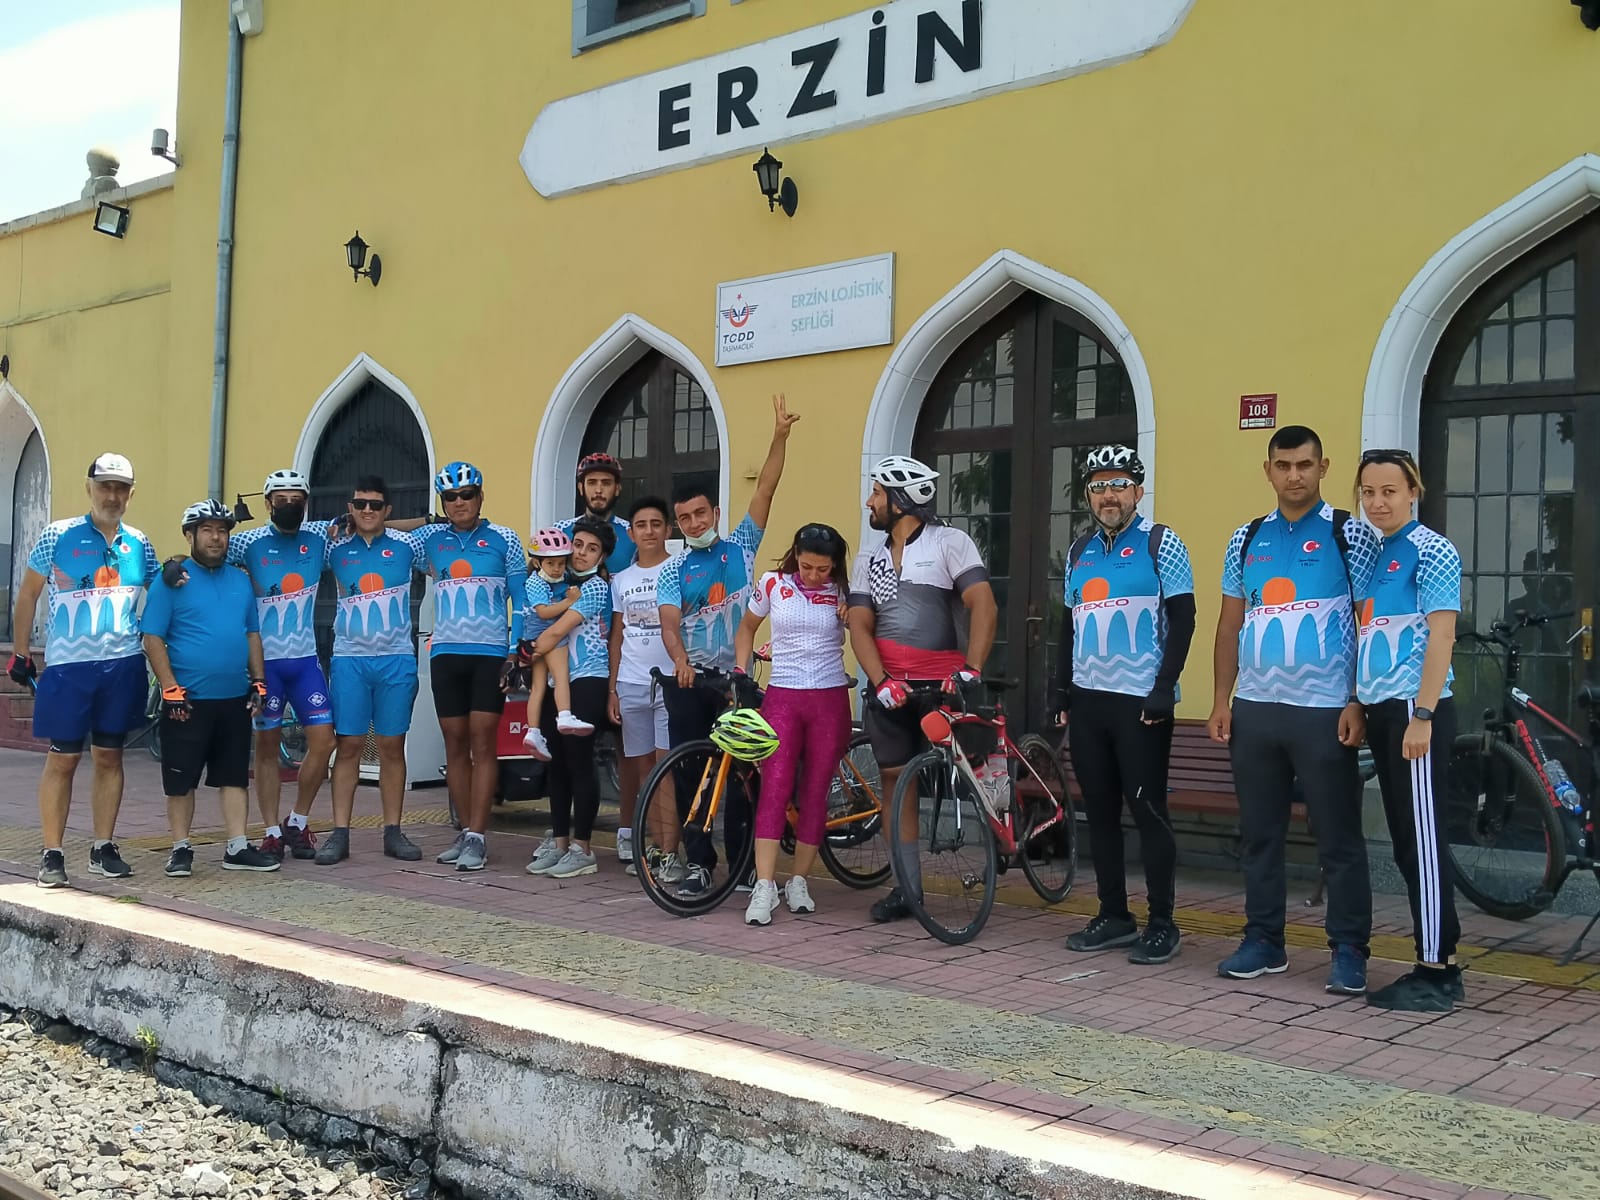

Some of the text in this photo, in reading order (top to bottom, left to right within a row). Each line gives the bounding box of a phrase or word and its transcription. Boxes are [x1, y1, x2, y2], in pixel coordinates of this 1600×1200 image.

[658, 0, 981, 151] ERZİN
[792, 278, 884, 308] ERZİN LOJİSTİK
[723, 330, 755, 344] TCDD
[1248, 404, 1269, 417] 108
